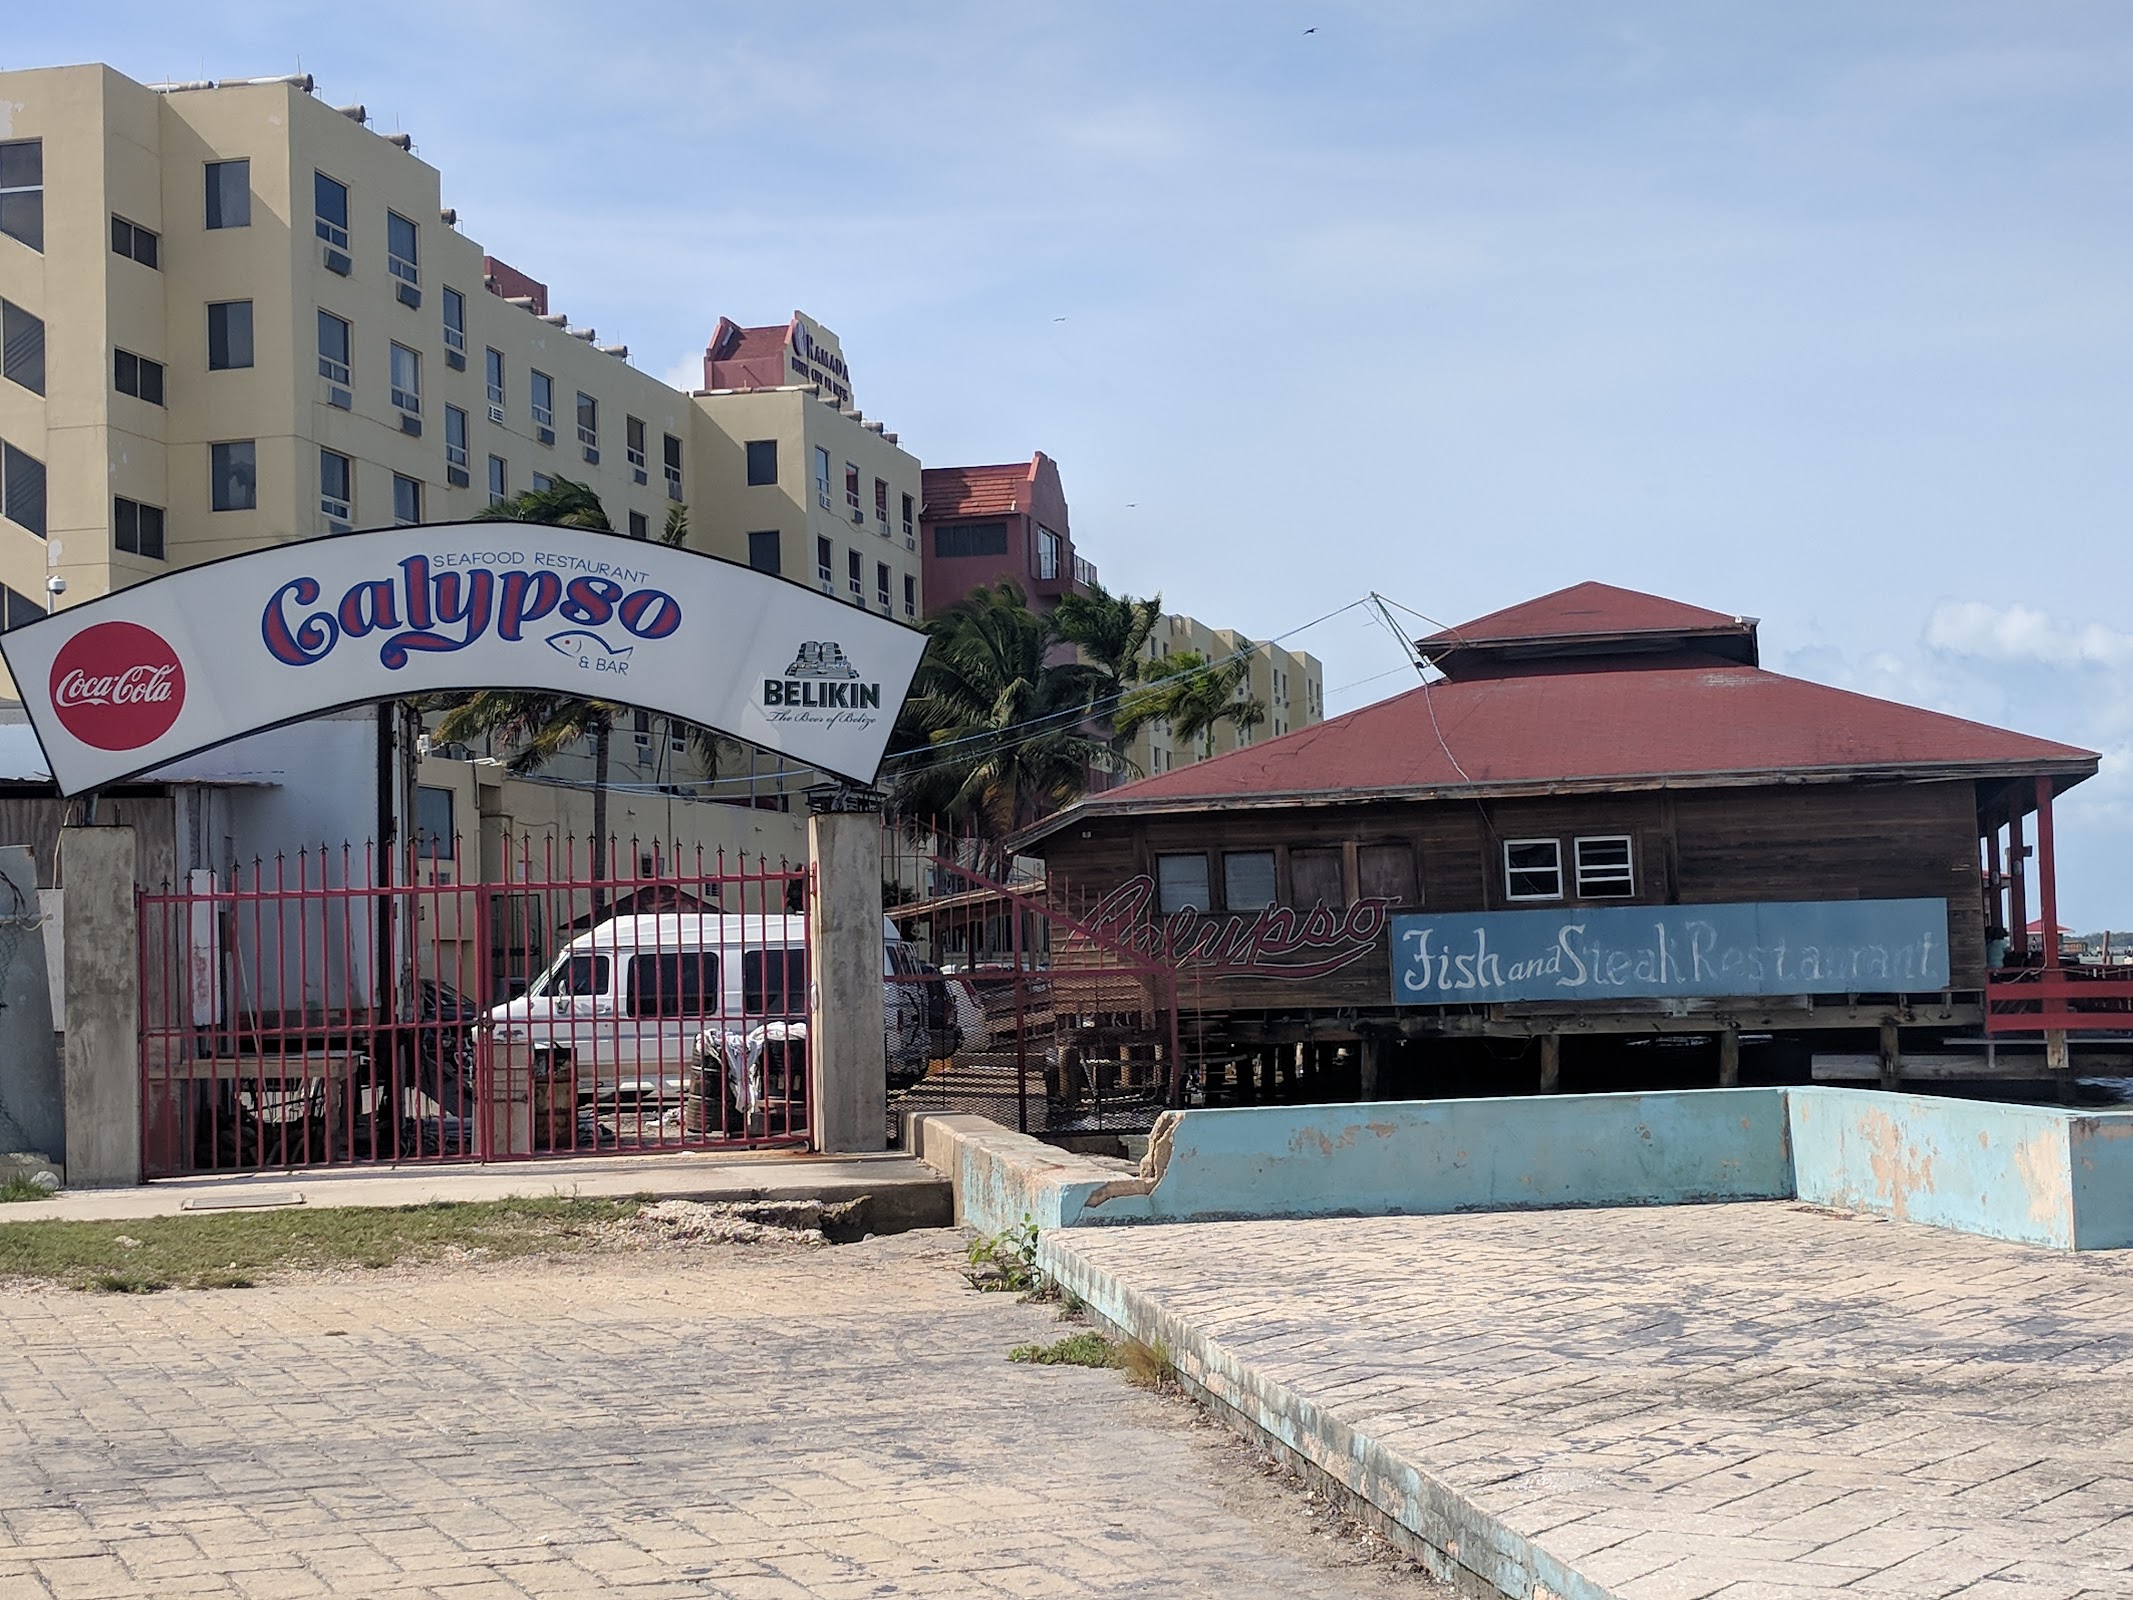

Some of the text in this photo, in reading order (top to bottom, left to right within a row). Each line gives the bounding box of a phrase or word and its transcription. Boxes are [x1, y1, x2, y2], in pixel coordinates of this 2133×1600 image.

[806, 334, 850, 383] RAMADA
[433, 552, 650, 585] SEAFOOD RESTAURANT
[261, 554, 683, 671] Calypso
[56, 664, 178, 708] Coca-Cola
[579, 655, 630, 676] & BAR
[763, 679, 880, 709] BELIKIN
[766, 709, 877, 731] The Beer of Belize
[1060, 873, 1403, 981] Calypso
[1402, 926, 1506, 991] Fish
[1508, 944, 1562, 981] and
[1555, 922, 1686, 988] Steak
